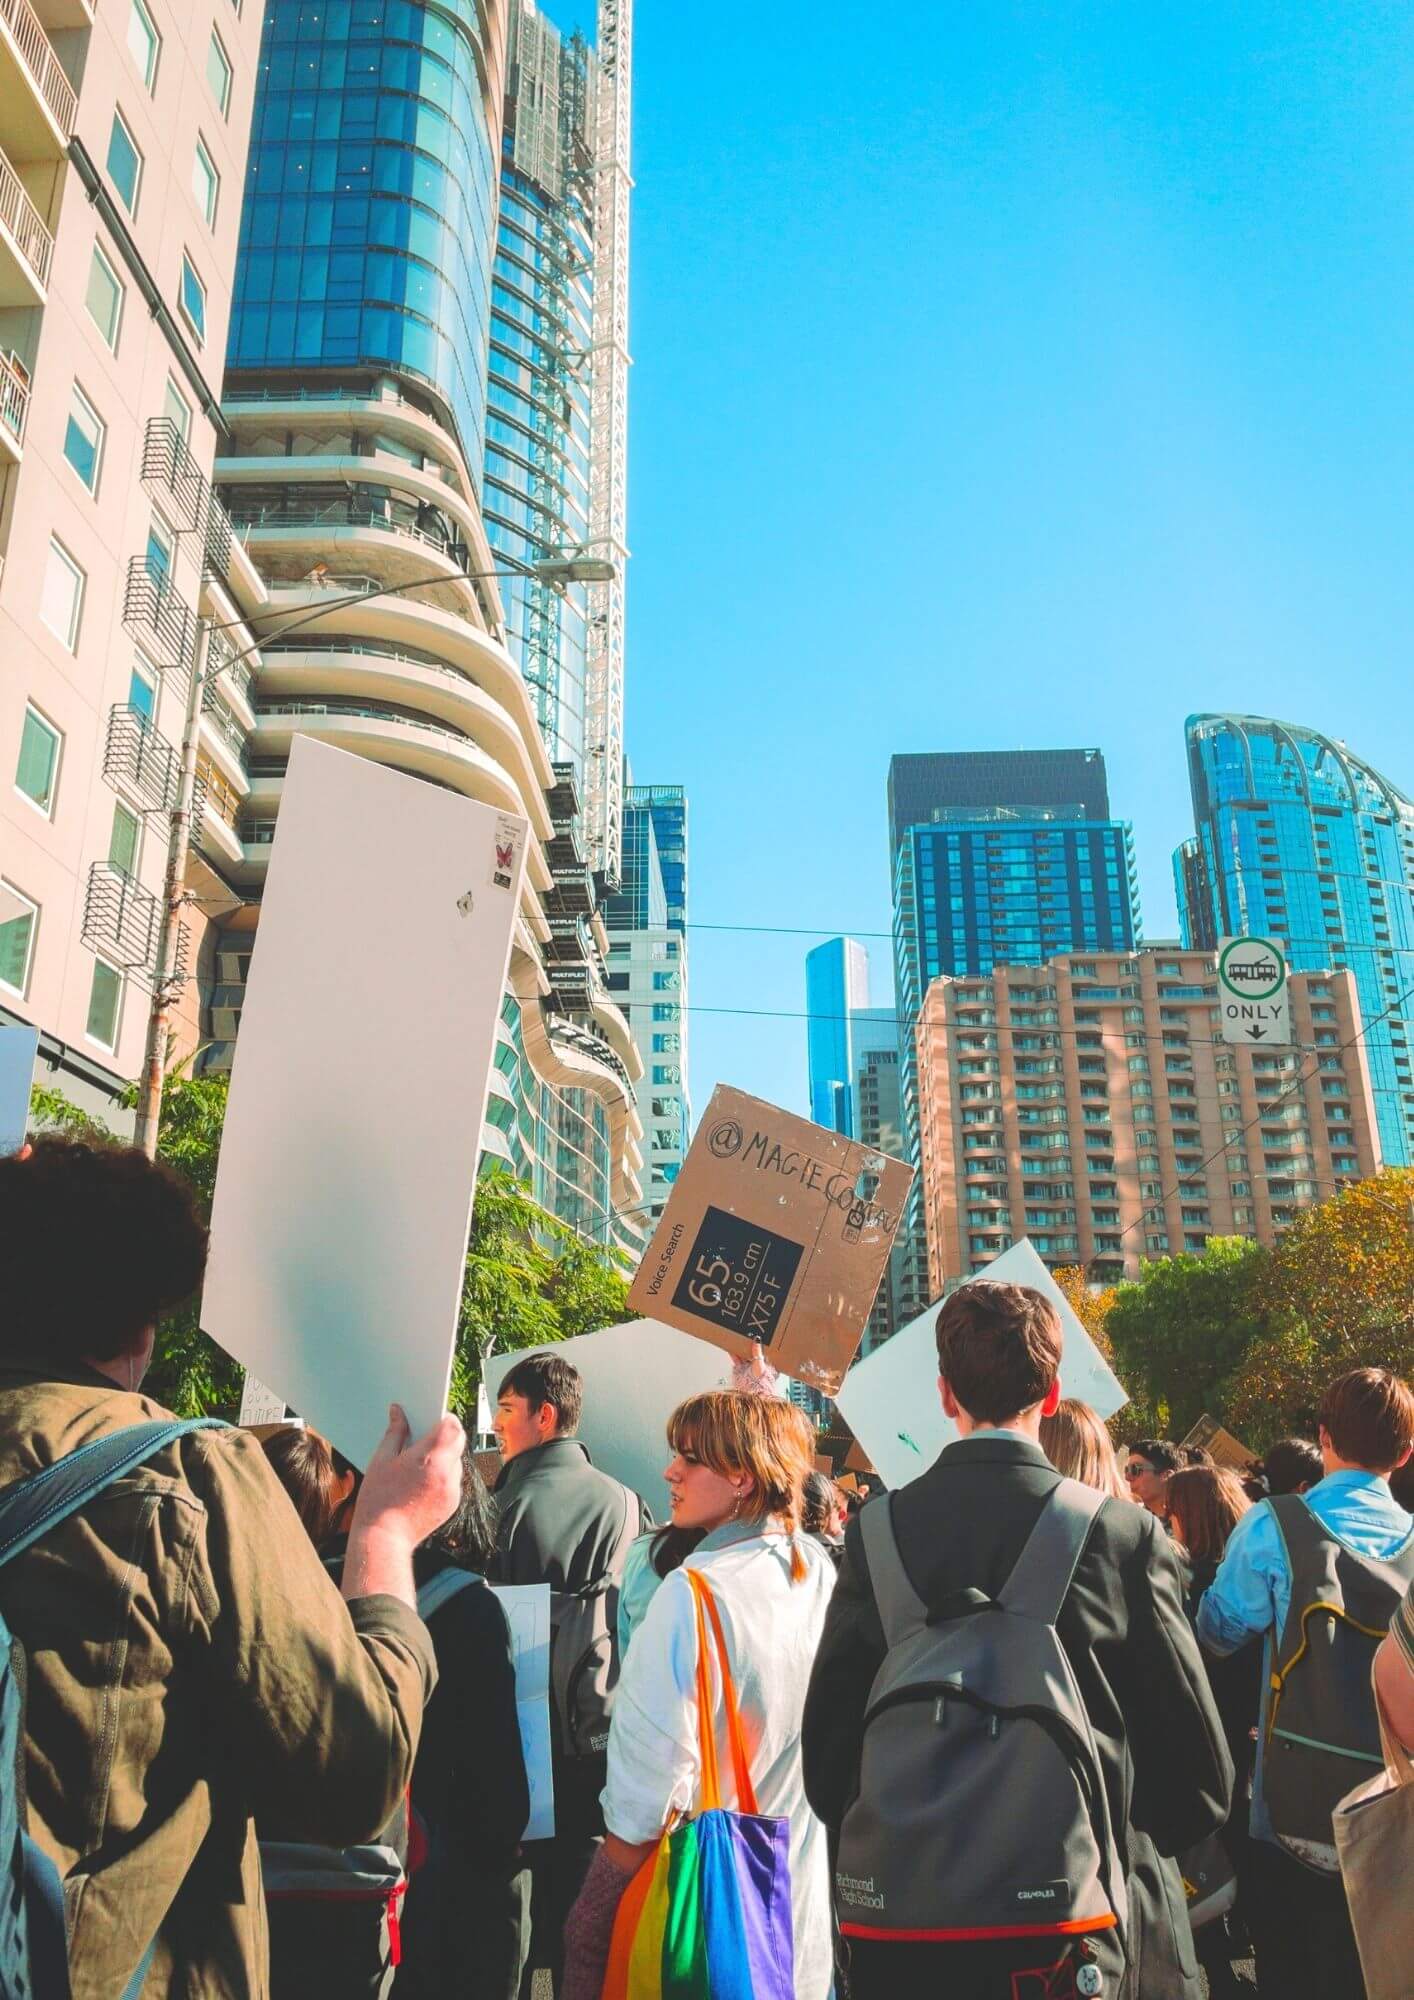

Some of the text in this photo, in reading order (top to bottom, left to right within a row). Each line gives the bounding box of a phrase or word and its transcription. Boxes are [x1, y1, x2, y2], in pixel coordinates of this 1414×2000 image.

[1226, 1004, 1283, 1020] ONLY
[647, 1223, 686, 1296] Voice Search
[688, 1254, 731, 1308] 65
[721, 1242, 763, 1318] 163.9 cm
[747, 1272, 782, 1334] X75 F
